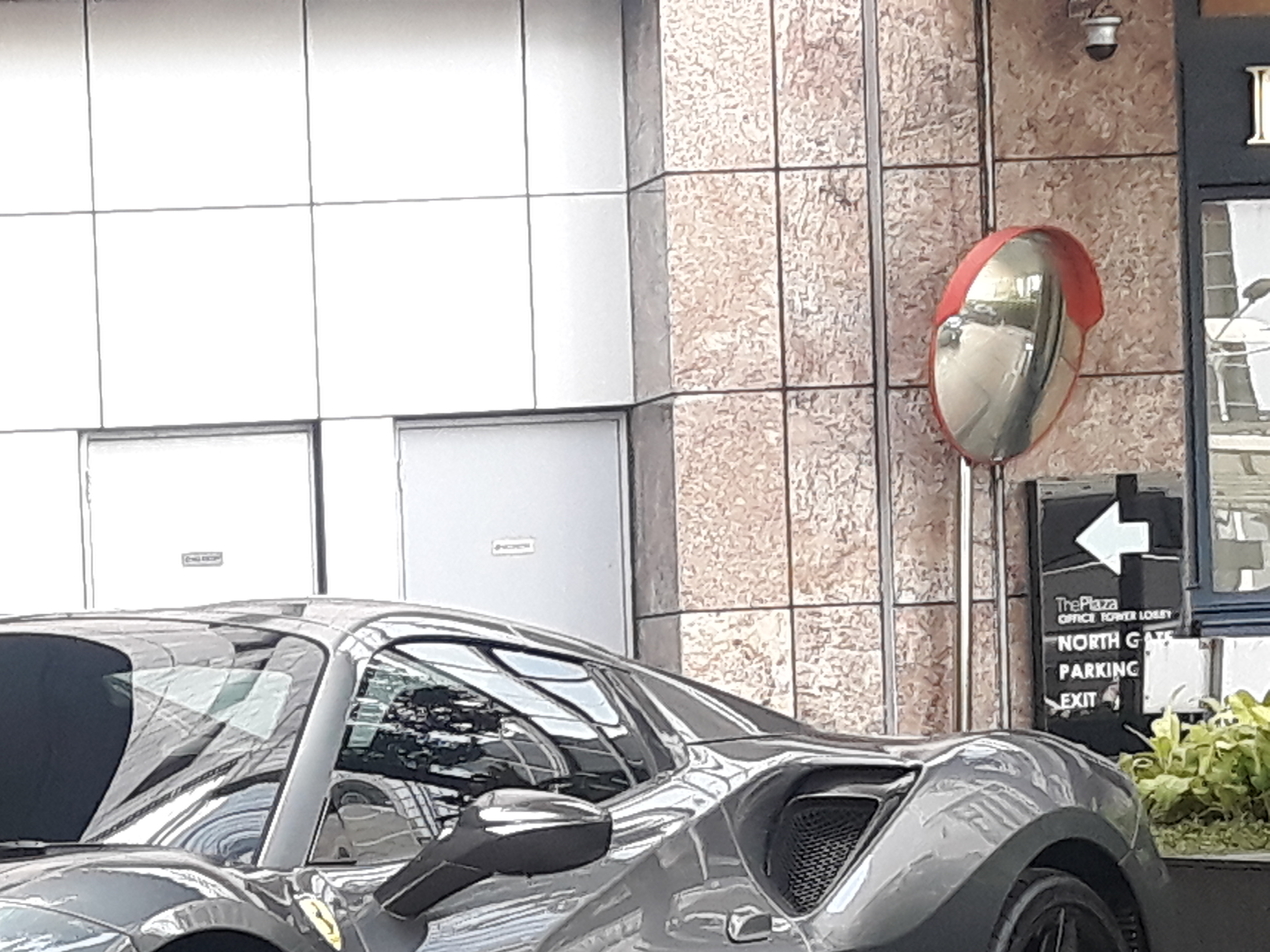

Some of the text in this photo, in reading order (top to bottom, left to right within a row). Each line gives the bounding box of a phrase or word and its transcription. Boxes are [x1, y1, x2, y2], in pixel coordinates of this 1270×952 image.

[1058, 631, 1120, 652] NORTH
[1059, 661, 1139, 680] PARKING
[1060, 692, 1097, 708] EXIT
